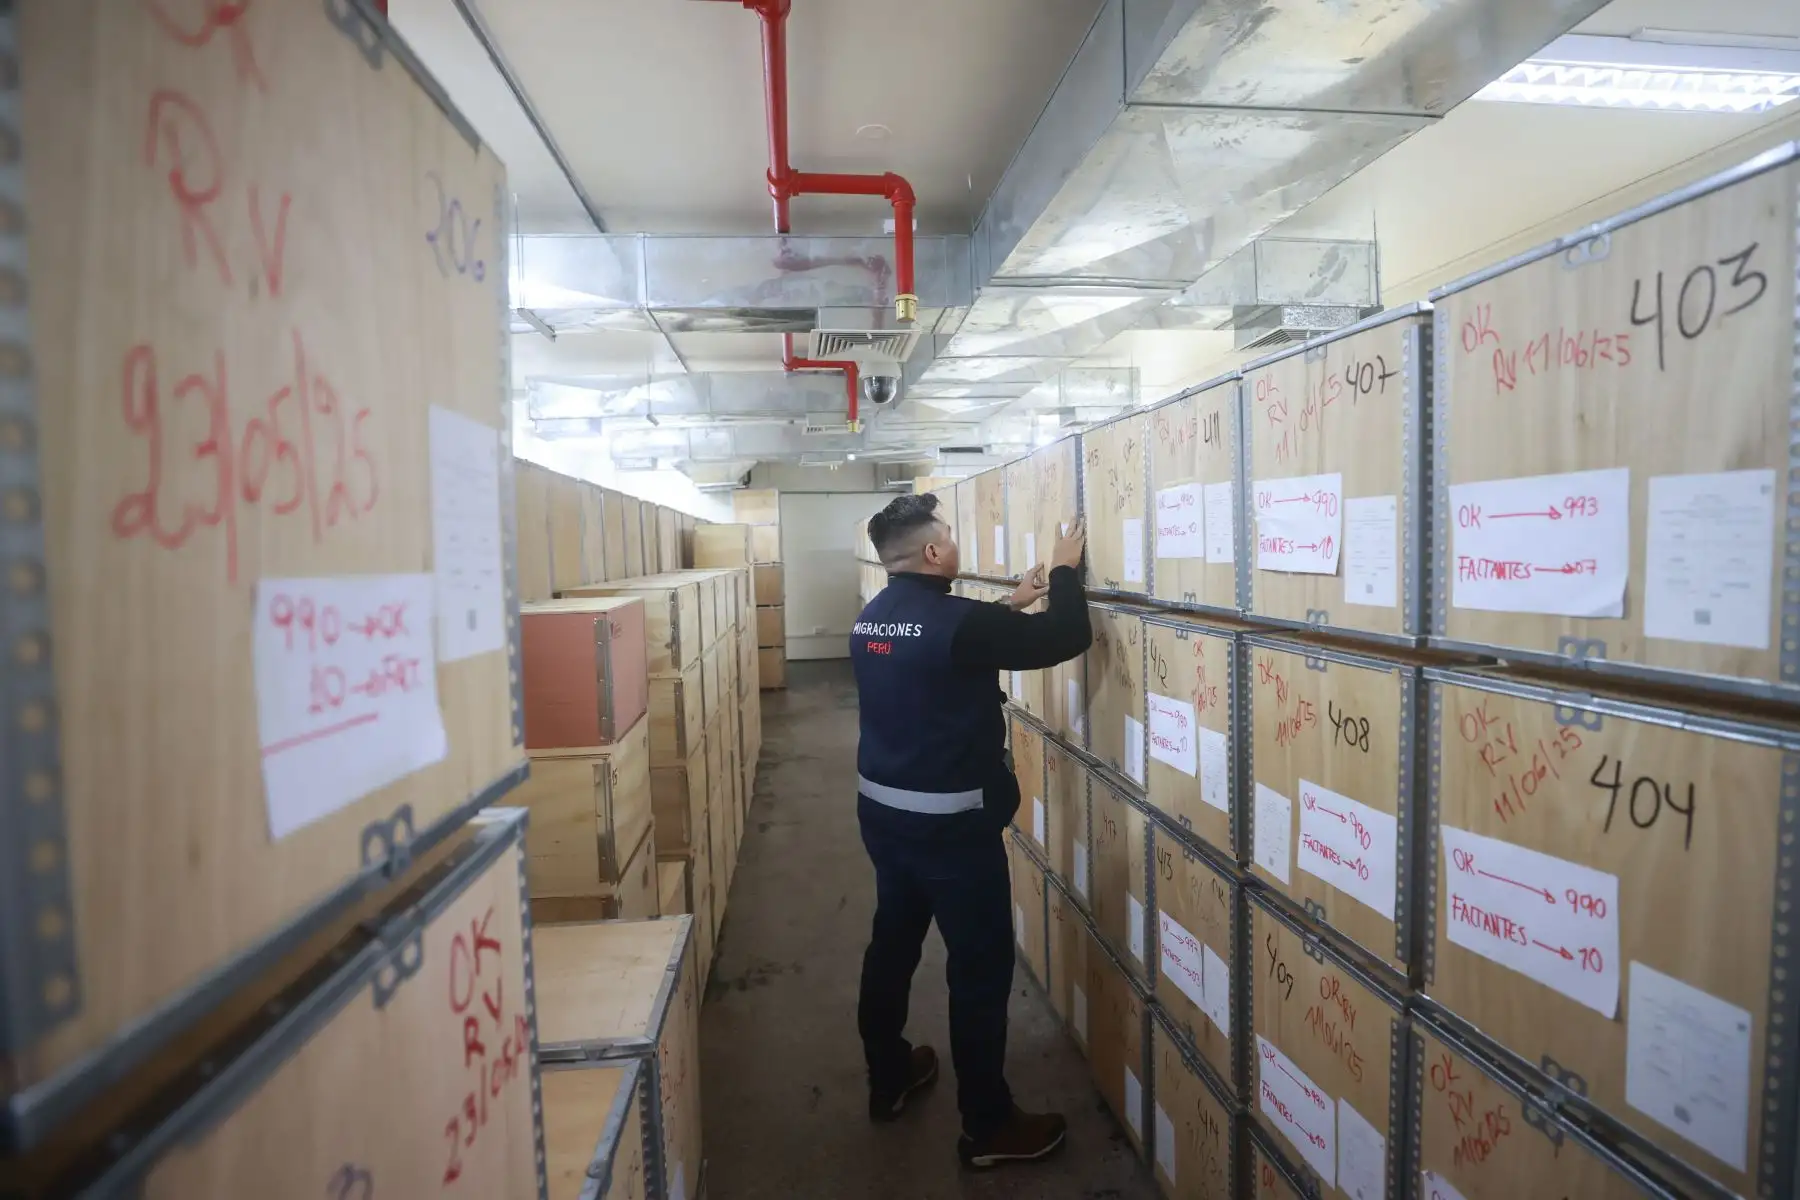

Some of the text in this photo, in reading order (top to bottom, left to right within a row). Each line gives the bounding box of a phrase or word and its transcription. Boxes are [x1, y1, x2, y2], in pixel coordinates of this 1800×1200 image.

[1461, 302, 1501, 355] OK
[1628, 241, 1768, 372] 403
[1256, 373, 1280, 402] OK
[1345, 354, 1401, 407] 407
[1257, 489, 1339, 518] OK 990
[1458, 495, 1600, 530] OK 993
[268, 592, 342, 654] 990
[852, 622, 923, 637] MIGRACIONES
[1328, 699, 1370, 754] 408
[1459, 698, 1500, 744] OK
[1480, 722, 1519, 778] RV
[1493, 726, 1583, 825] 11/06/25
[1303, 792, 1371, 851] OK 990
[1590, 754, 1696, 852] 404
[1452, 847, 1608, 920] OK 990
[450, 904, 502, 1015] OK
[1266, 932, 1294, 1001] 409
[1430, 1053, 1461, 1092] OK
